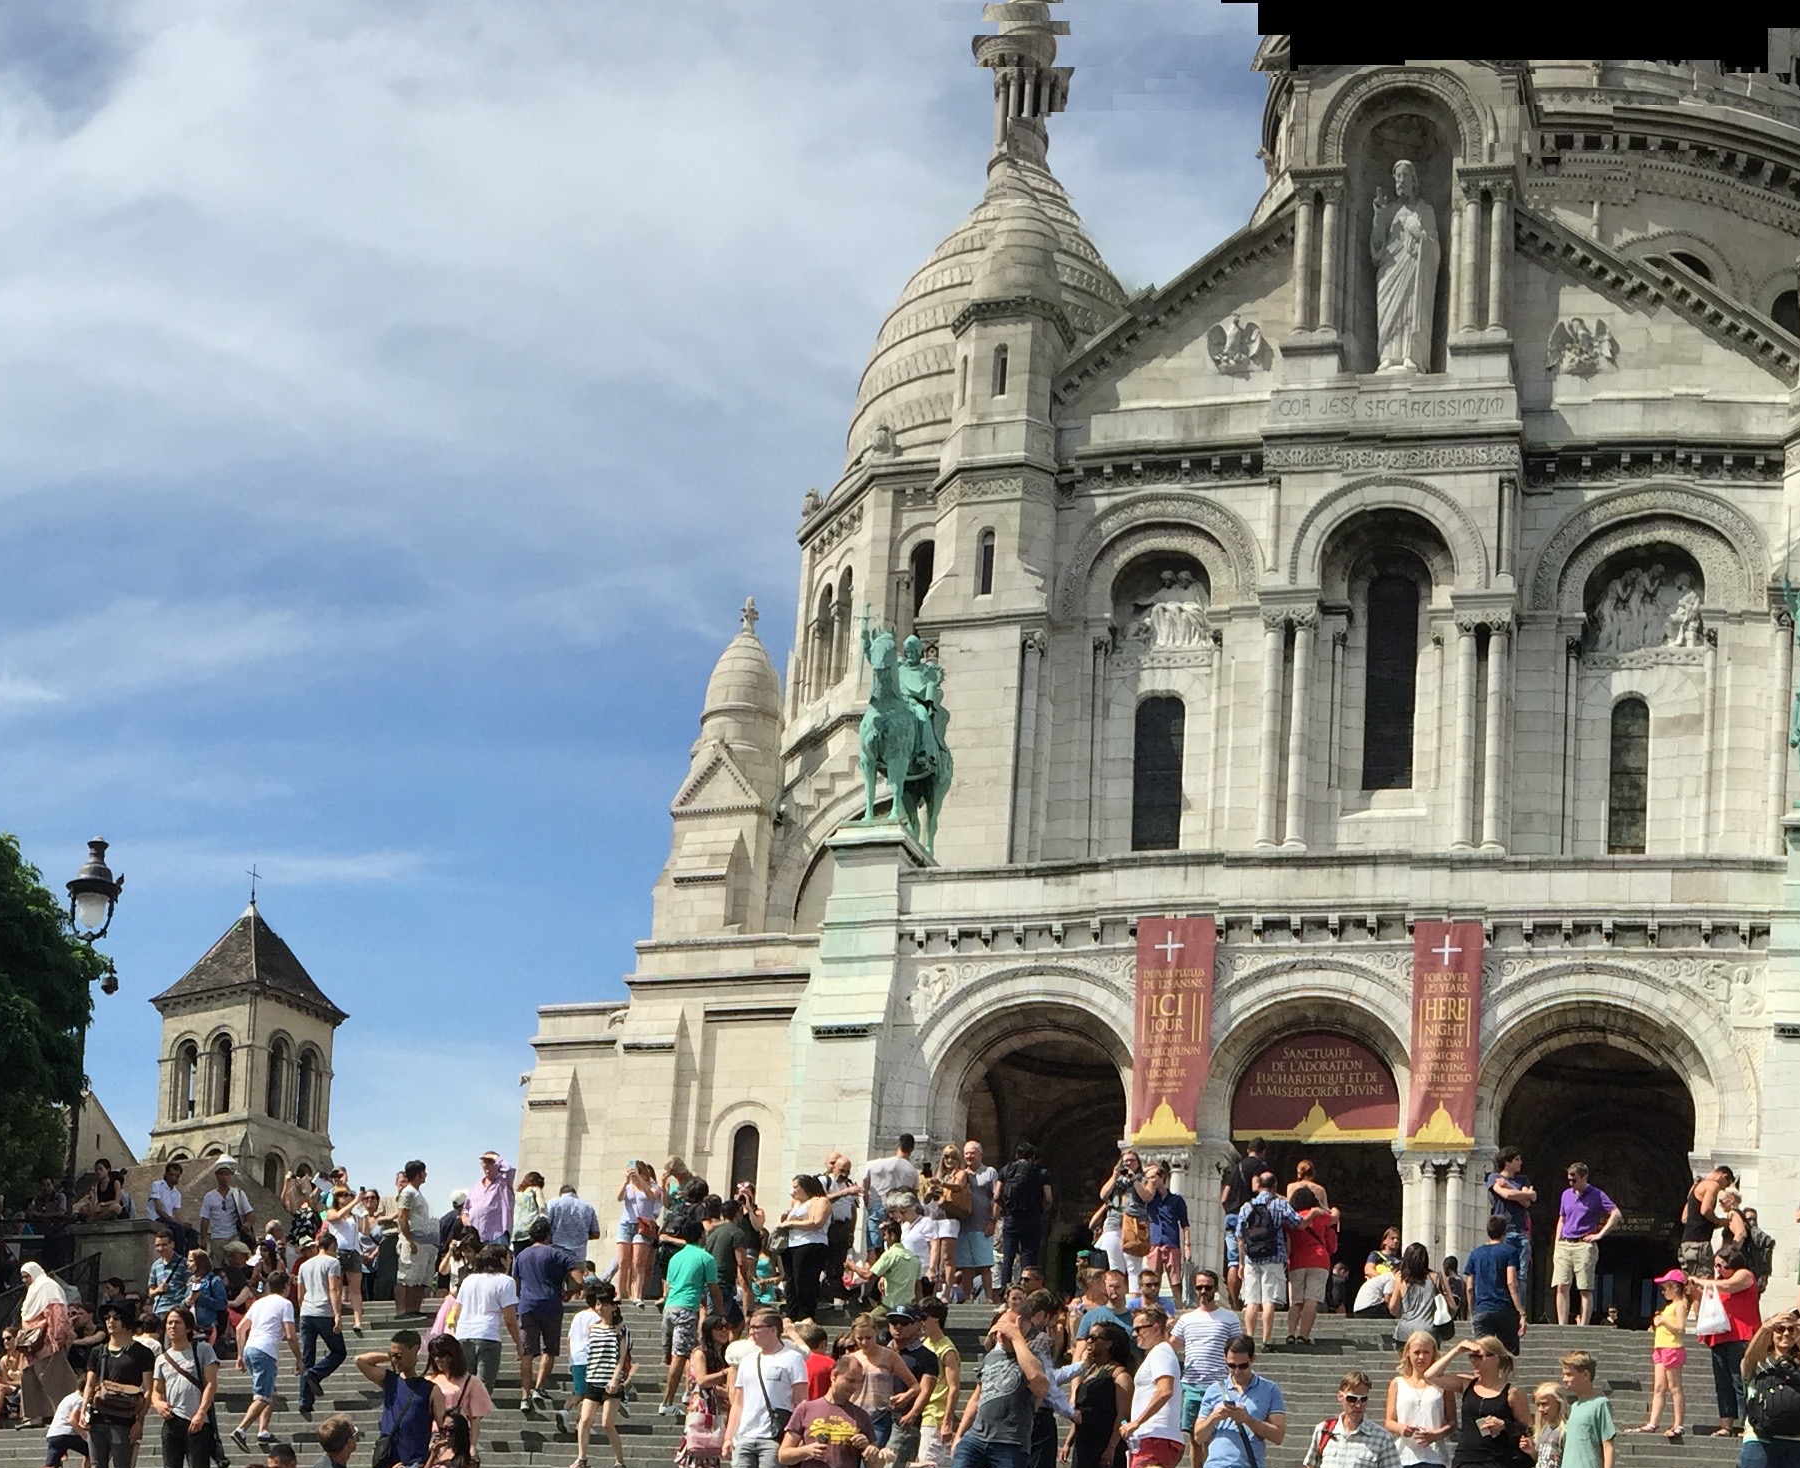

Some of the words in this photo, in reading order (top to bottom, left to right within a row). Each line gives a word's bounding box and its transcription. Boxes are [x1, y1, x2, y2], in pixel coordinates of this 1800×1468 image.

[1279, 399, 1311, 417] COR
[1424, 972, 1441, 982] FOR
[1443, 972, 1469, 982] OVER
[1424, 982, 1438, 993] 125
[1151, 993, 1184, 1017] ICI
[1425, 997, 1466, 1021] HERE
[1151, 1018, 1185, 1034] JOUR
[1424, 1023, 1465, 1037] NIGHT
[1149, 1035, 1159, 1044] ET
[1424, 1039, 1444, 1049] AND
[1282, 1046, 1352, 1060] SANCTUAIRE
[1422, 1051, 1465, 1061] SOMEONE
[1272, 1061, 1286, 1072] DE
[1290, 1060, 1363, 1072] L'ADORATION
[1419, 1063, 1427, 1072] IS
[1429, 1062, 1467, 1072] PRAYING
[1256, 1072, 1345, 1085] EUCHARISTIQUE
[1348, 1072, 1362, 1083] ET
[1364, 1072, 1379, 1083] DE
[1414, 1073, 1426, 1083] TO
[1429, 1073, 1446, 1083] THE
[1250, 1085, 1263, 1096] LA
[1345, 1084, 1385, 1097] DIVINE
